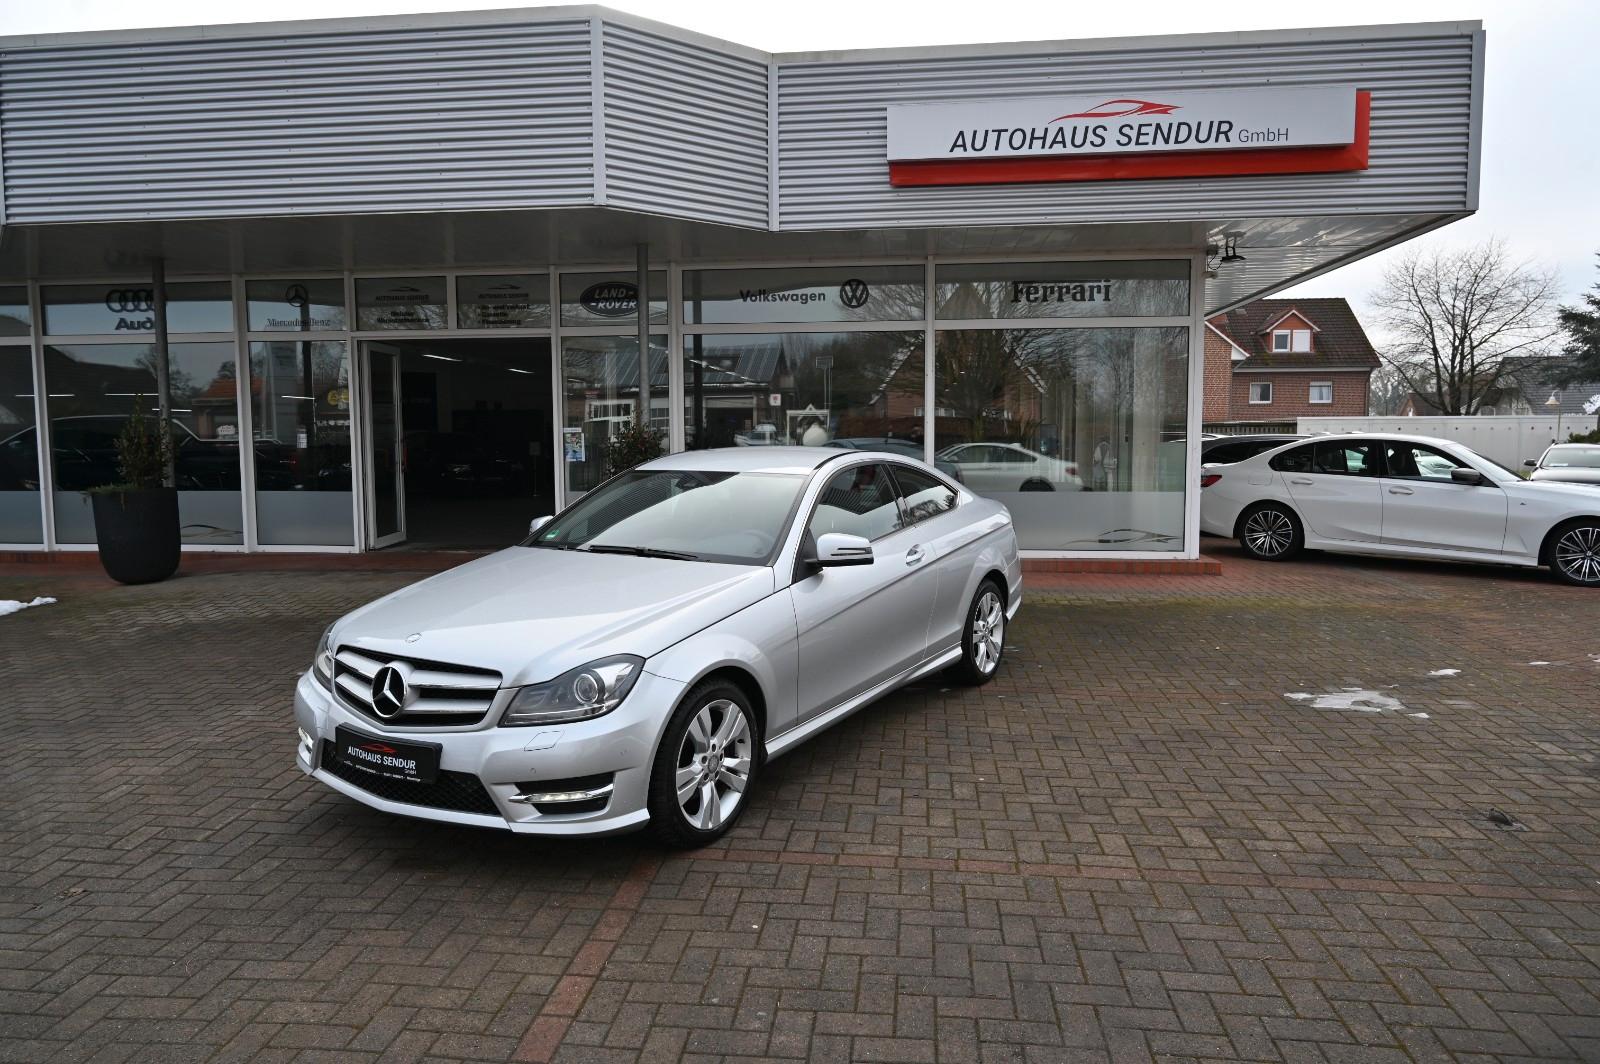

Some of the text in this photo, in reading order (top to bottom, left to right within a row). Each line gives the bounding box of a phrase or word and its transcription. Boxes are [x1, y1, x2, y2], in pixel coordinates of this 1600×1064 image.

[949, 120, 1289, 152] AUTOHAUS SENDUR GmbH
[740, 289, 826, 304] Volkswagen
[1011, 279, 1112, 302] Ferrari
[115, 316, 154, 330] Aud
[348, 746, 416, 770] AUTOHAUS SENDUR
